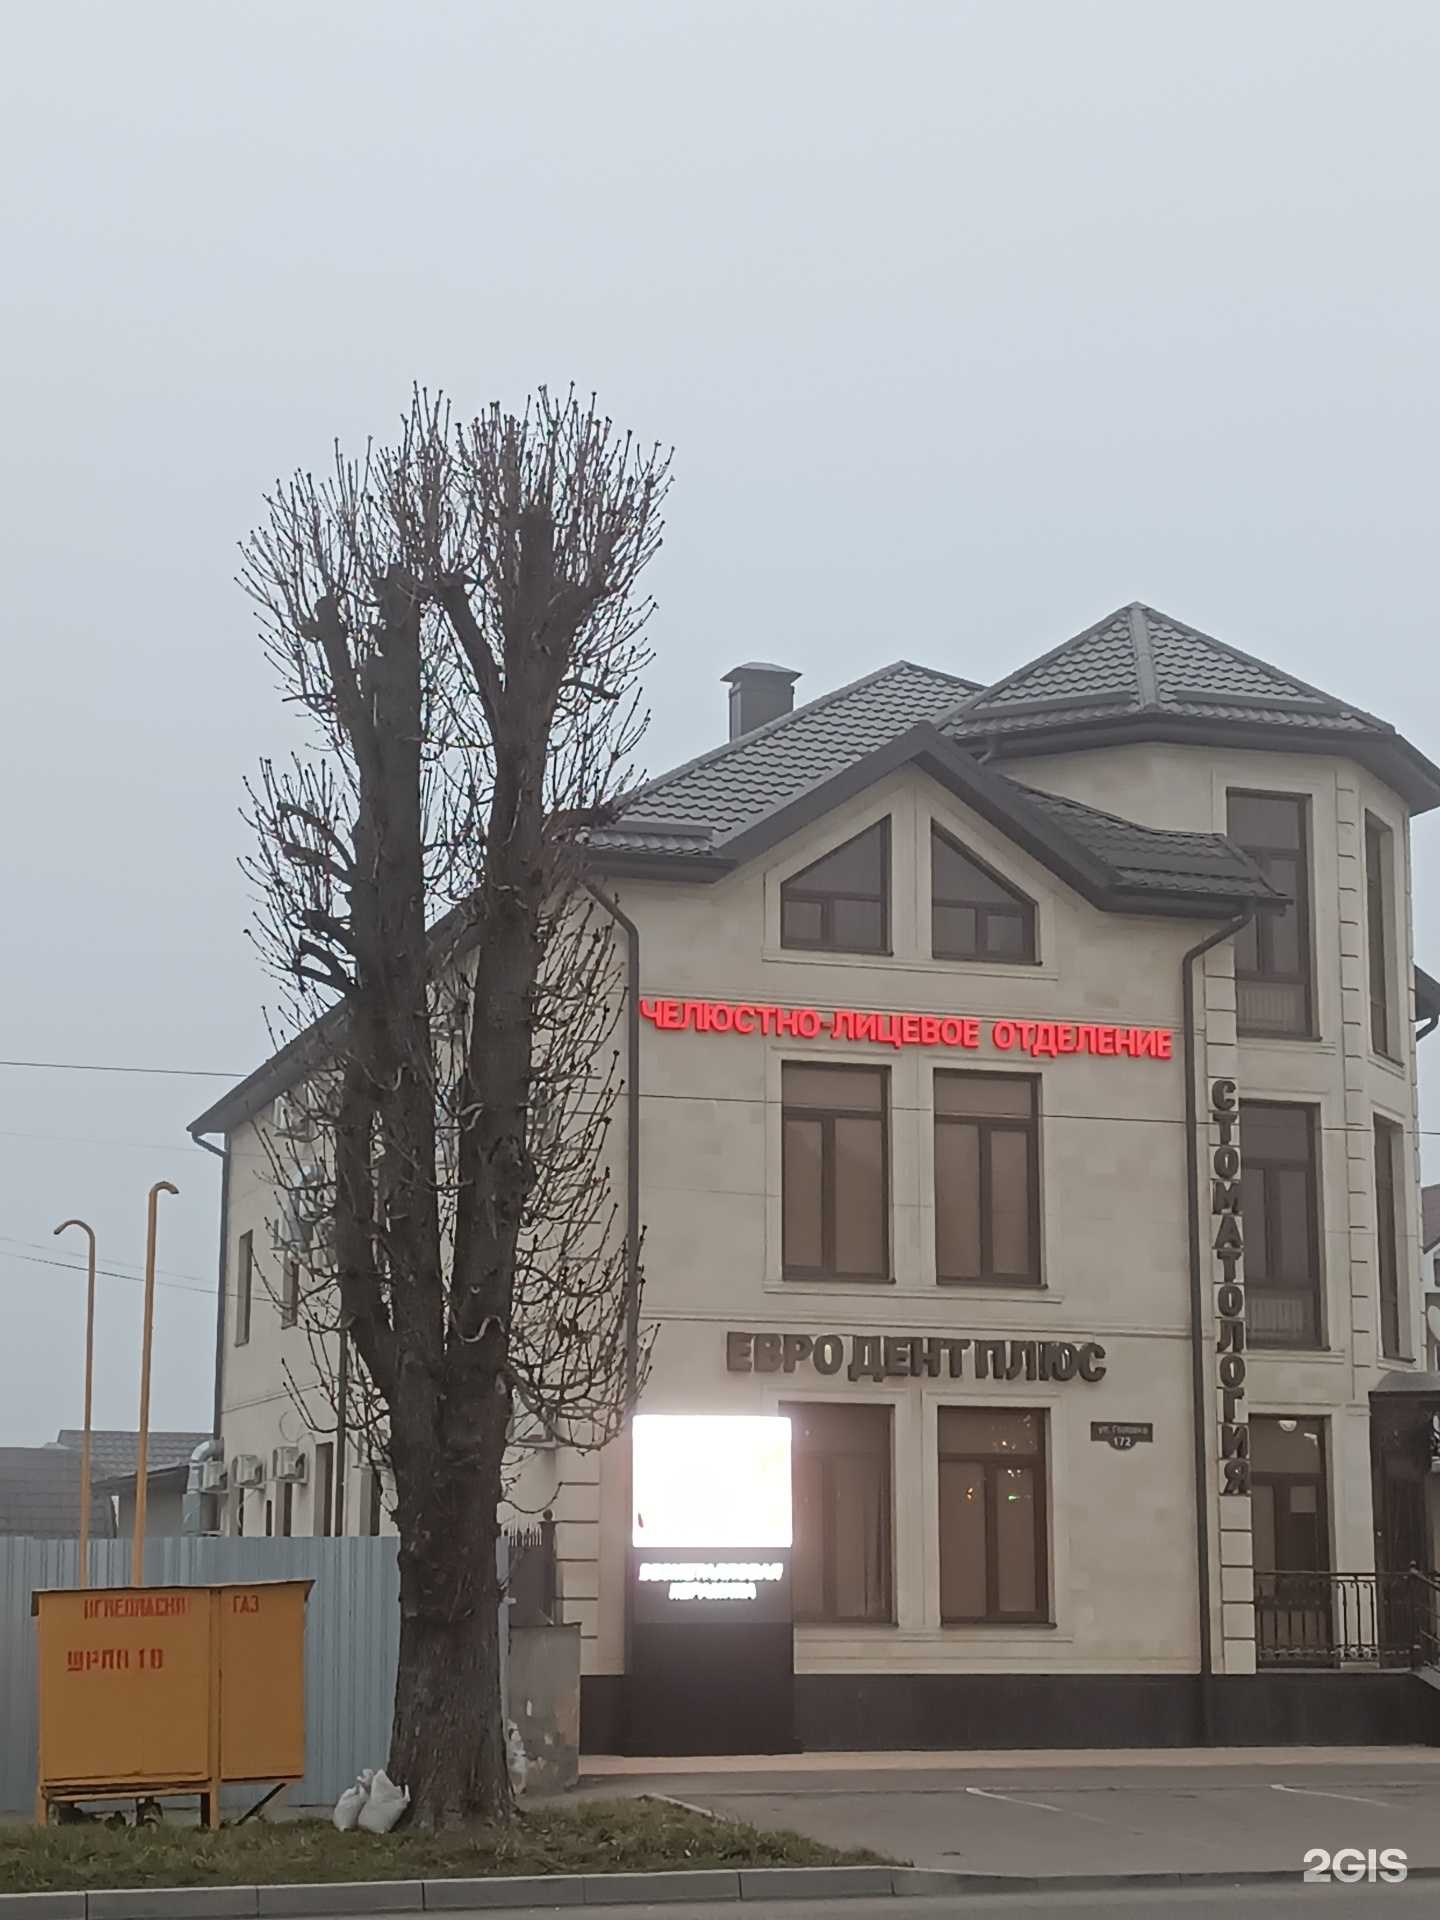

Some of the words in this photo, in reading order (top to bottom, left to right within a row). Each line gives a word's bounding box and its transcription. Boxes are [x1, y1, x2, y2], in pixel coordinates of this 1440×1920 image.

[639, 998, 980, 1049] ЧЕЛЮСТНО-ЛИЦЕВОЕ
[992, 1019, 1174, 1061] ОТДЕЛЕНИЕ
[1211, 1079, 1251, 1496] СТОМАТОЛОГИЯ
[973, 1340, 1107, 1382] ПЛЮС
[1113, 1436, 1131, 1447] 172
[232, 1595, 260, 1613] ГАЗ
[139, 1648, 163, 1669] 10
